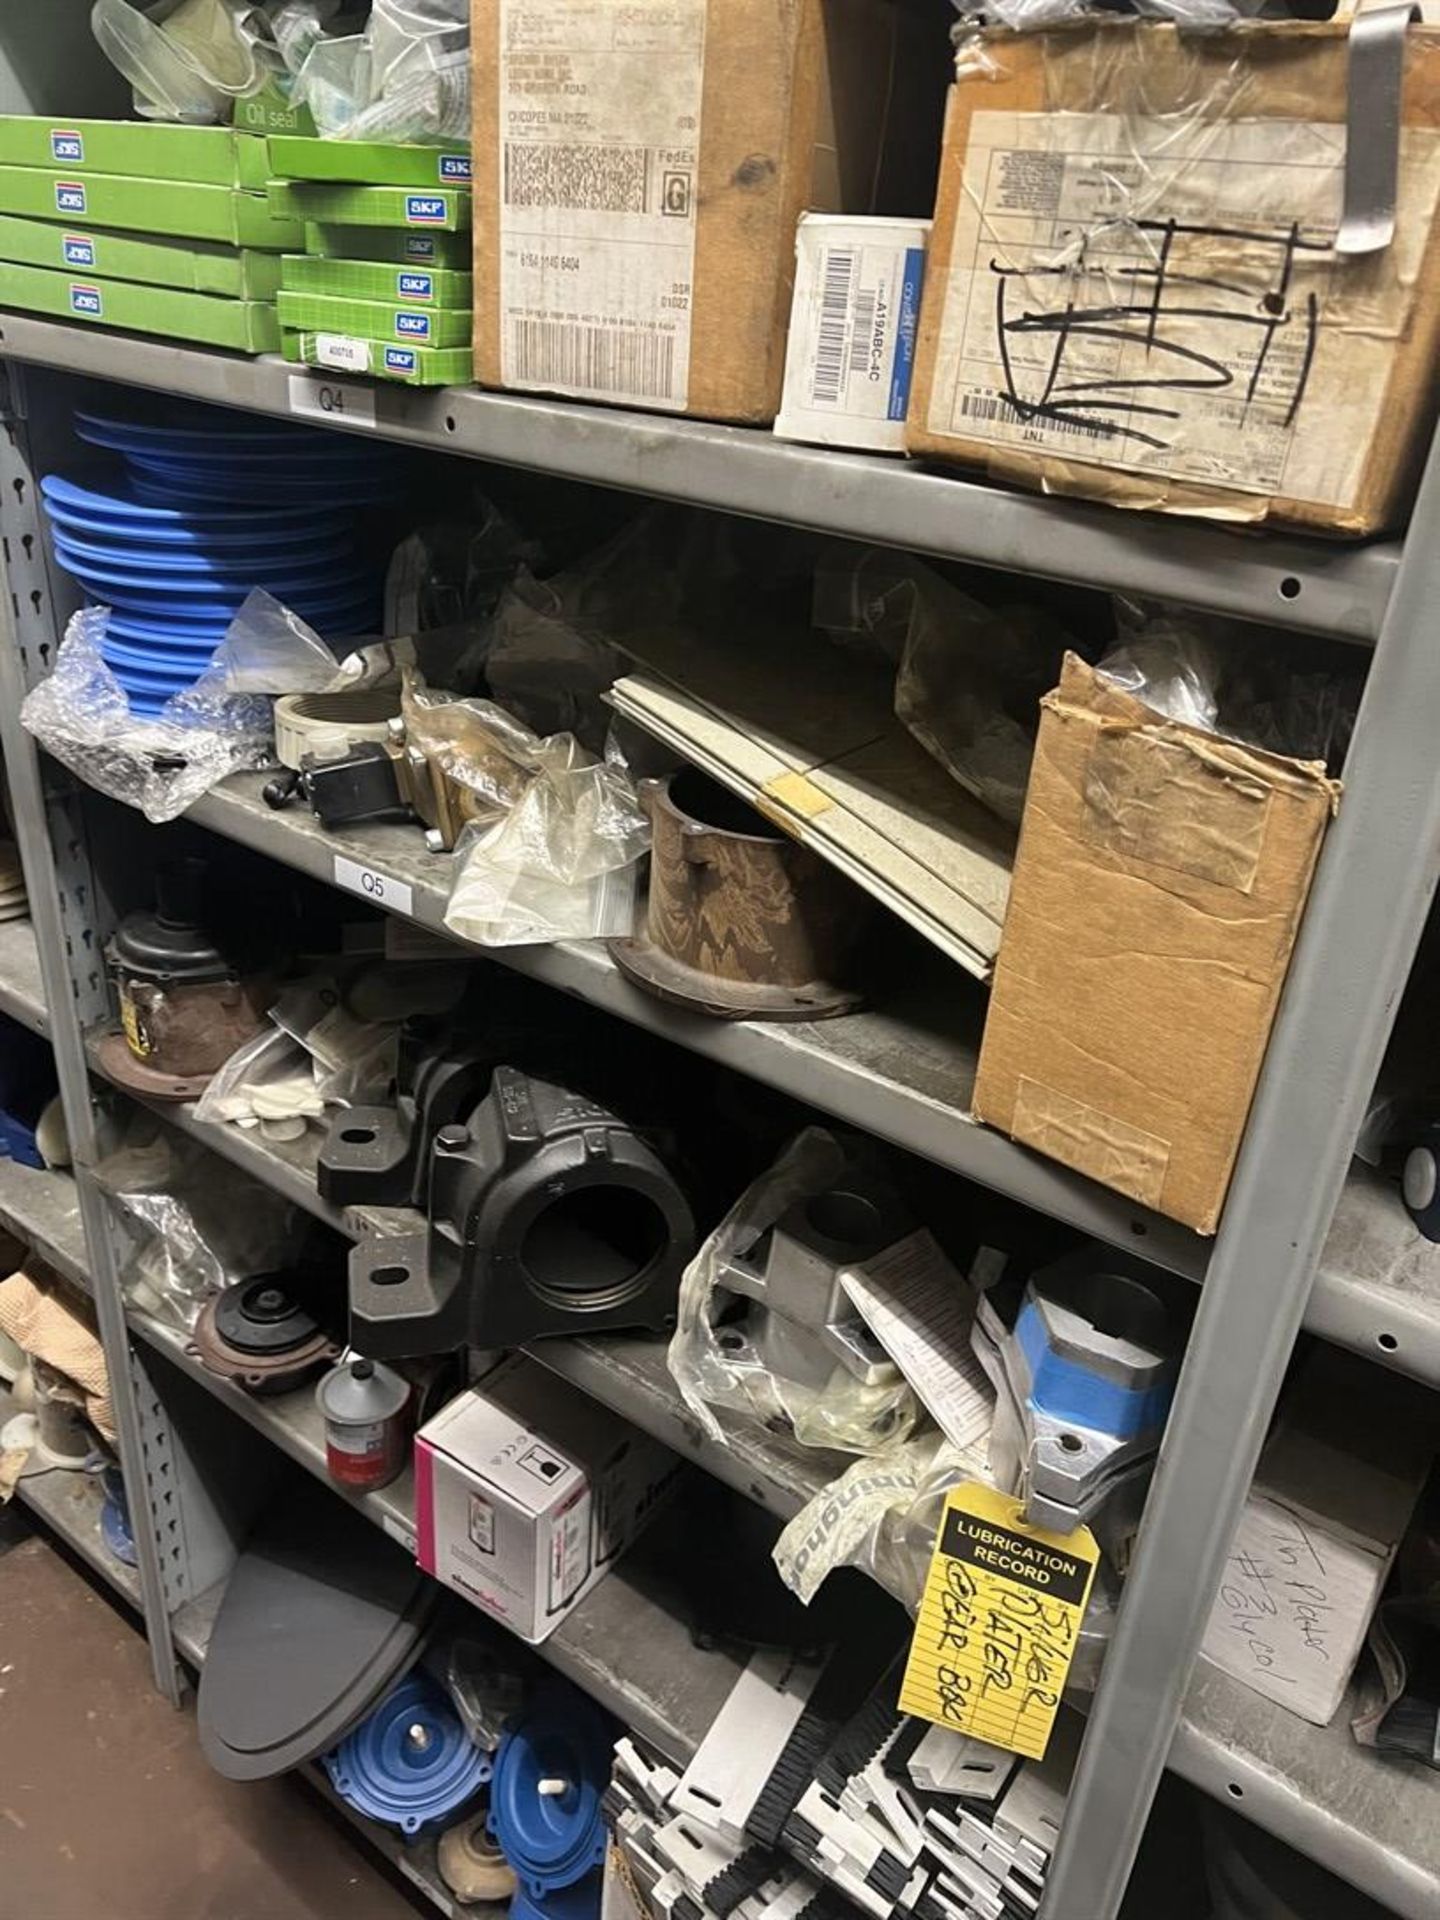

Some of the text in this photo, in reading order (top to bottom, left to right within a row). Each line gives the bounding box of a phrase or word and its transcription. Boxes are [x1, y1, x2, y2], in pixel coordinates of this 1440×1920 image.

[246, 103, 298, 128] Oil seal
[410, 201, 442, 213] SKF
[667, 177, 685, 212] G
[402, 279, 429, 291] SKF
[399, 317, 426, 330] SKF
[388, 353, 412, 366] SKF
[319, 387, 344, 413] Q4
[1022, 429, 1044, 443] TNT
[361, 872, 384, 897] Q5
[957, 1520, 1077, 1577] LUBRICATION
[973, 1545, 1051, 1584] RECORD
